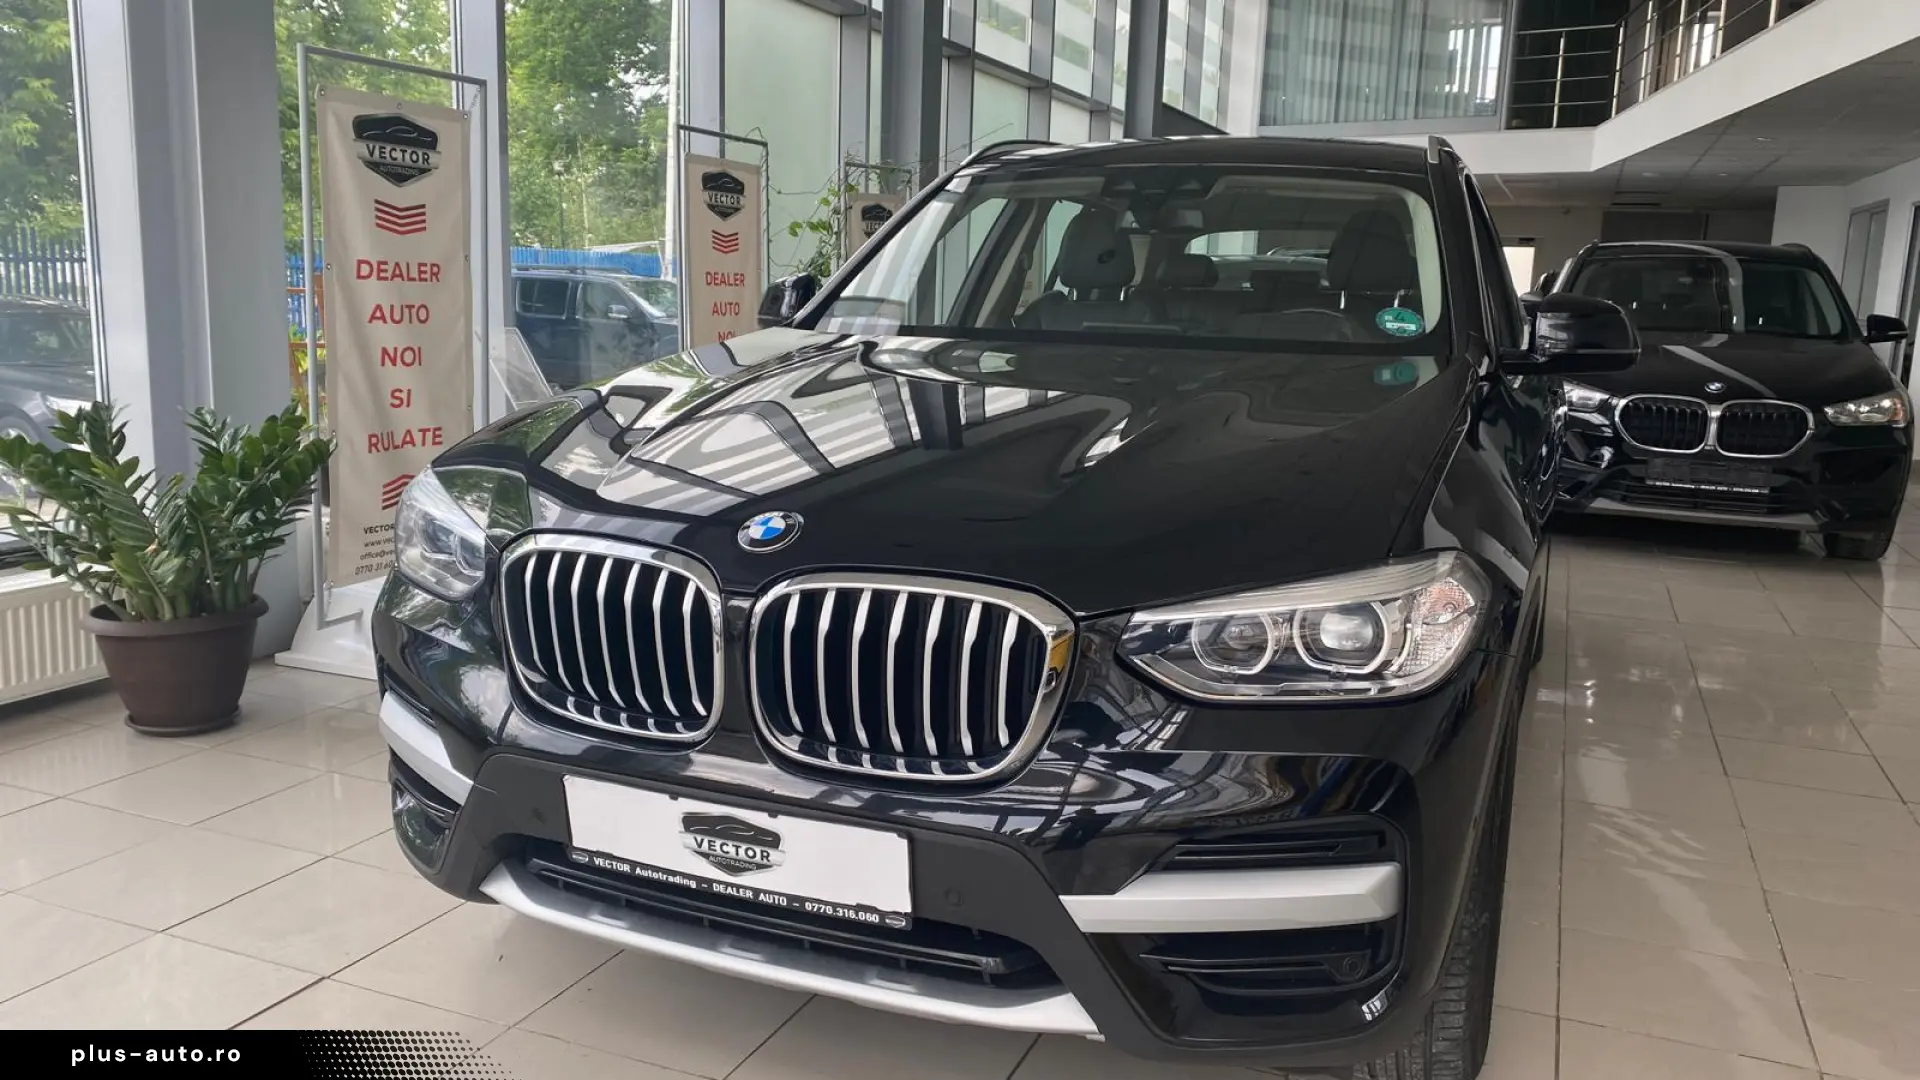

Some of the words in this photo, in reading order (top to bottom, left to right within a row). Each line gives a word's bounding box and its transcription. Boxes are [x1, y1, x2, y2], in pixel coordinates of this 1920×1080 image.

[366, 143, 430, 166] VECTOR
[708, 191, 741, 205] VECTOR
[356, 259, 441, 283] DEALER
[705, 271, 745, 288] DEALER
[368, 303, 430, 325] AUTO
[712, 302, 740, 317] AUTO
[380, 346, 422, 367] NOI
[390, 388, 412, 408] SI
[367, 427, 443, 453] RULATE
[693, 835, 771, 862] VECTOR
[708, 855, 757, 871] AUTOTRADING
[593, 856, 631, 873] VECTOR
[635, 867, 697, 889] Autotrading
[713, 882, 753, 899] DEALER
[758, 892, 787, 906] AUTO
[804, 901, 880, 923] 0770.316.060
